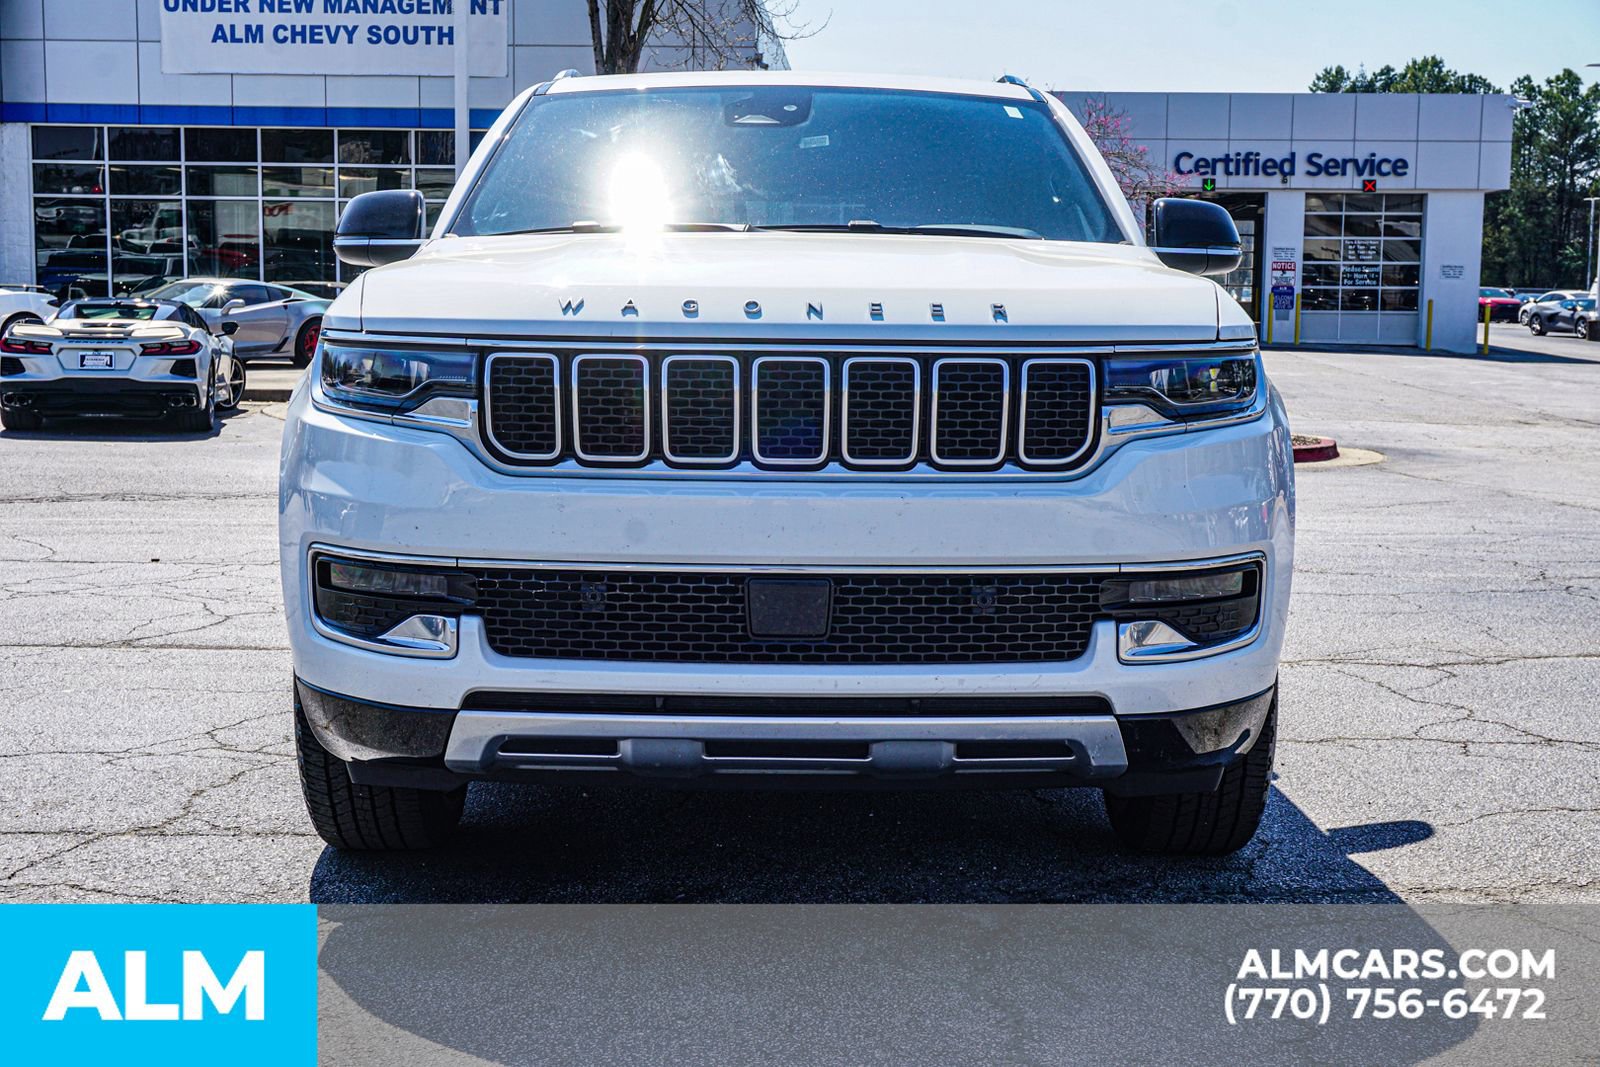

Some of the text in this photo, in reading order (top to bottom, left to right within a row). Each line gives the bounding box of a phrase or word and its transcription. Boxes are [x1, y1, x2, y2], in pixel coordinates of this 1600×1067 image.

[163, 0, 500, 15] UNDER NEW MANAGEMNT
[211, 23, 455, 46] ALM CHEVY SOUTH
[1173, 151, 1409, 178] Certified Service
[1272, 262, 1295, 270] NOTICE
[558, 297, 1009, 324] WAGONEER
